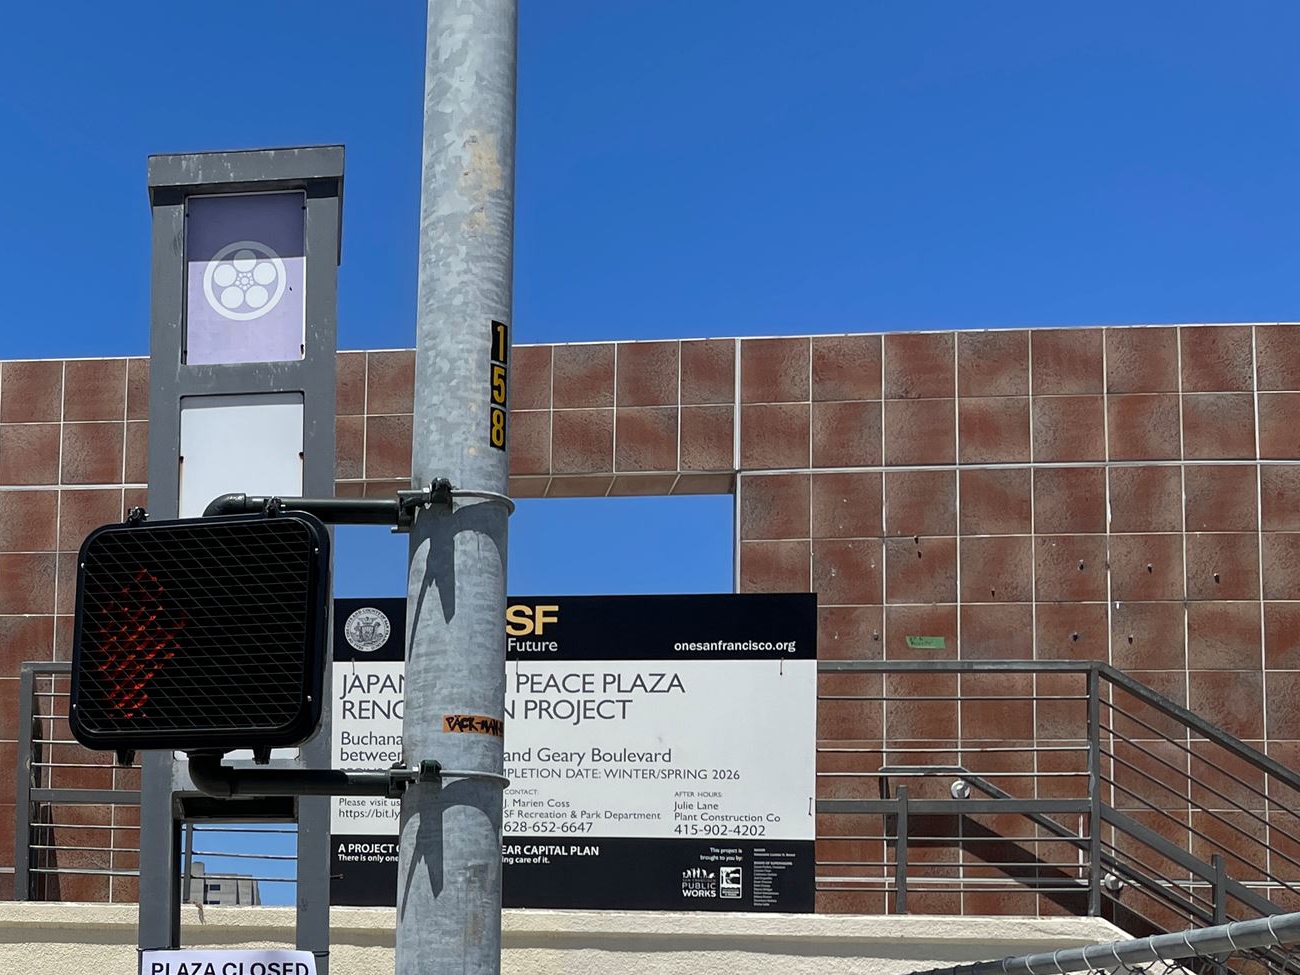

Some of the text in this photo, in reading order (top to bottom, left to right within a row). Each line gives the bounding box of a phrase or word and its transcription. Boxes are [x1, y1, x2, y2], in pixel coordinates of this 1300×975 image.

[491, 325, 506, 447] 158
[508, 638, 558, 652] Future
[674, 640, 796, 652] onesanfrancisco.org
[340, 673, 686, 699] JAPA PEACE PLAZA
[524, 700, 633, 726] PROJECT
[503, 748, 531, 762] and
[538, 748, 586, 766] Geary
[592, 748, 672, 762] Boulevard
[503, 768, 740, 780] PLETION DATE: WINTER/SPRING 2026
[339, 798, 366, 806] Please
[370, 798, 388, 806] visit
[513, 799, 544, 808] Marien
[547, 799, 570, 808] Coss
[674, 802, 718, 811] Julie Lane
[504, 810, 660, 821] SF Recreation & Park Department
[675, 812, 780, 822] Plant Construction Co
[504, 822, 593, 832] 628-652-6647
[674, 825, 765, 836] 415-902-4202
[338, 844, 346, 853] A
[348, 844, 394, 853] PROJECT
[524, 845, 568, 855] CAPITAL
[570, 846, 599, 856] PLAN
[338, 854, 359, 862] There
[368, 855, 384, 863] only
